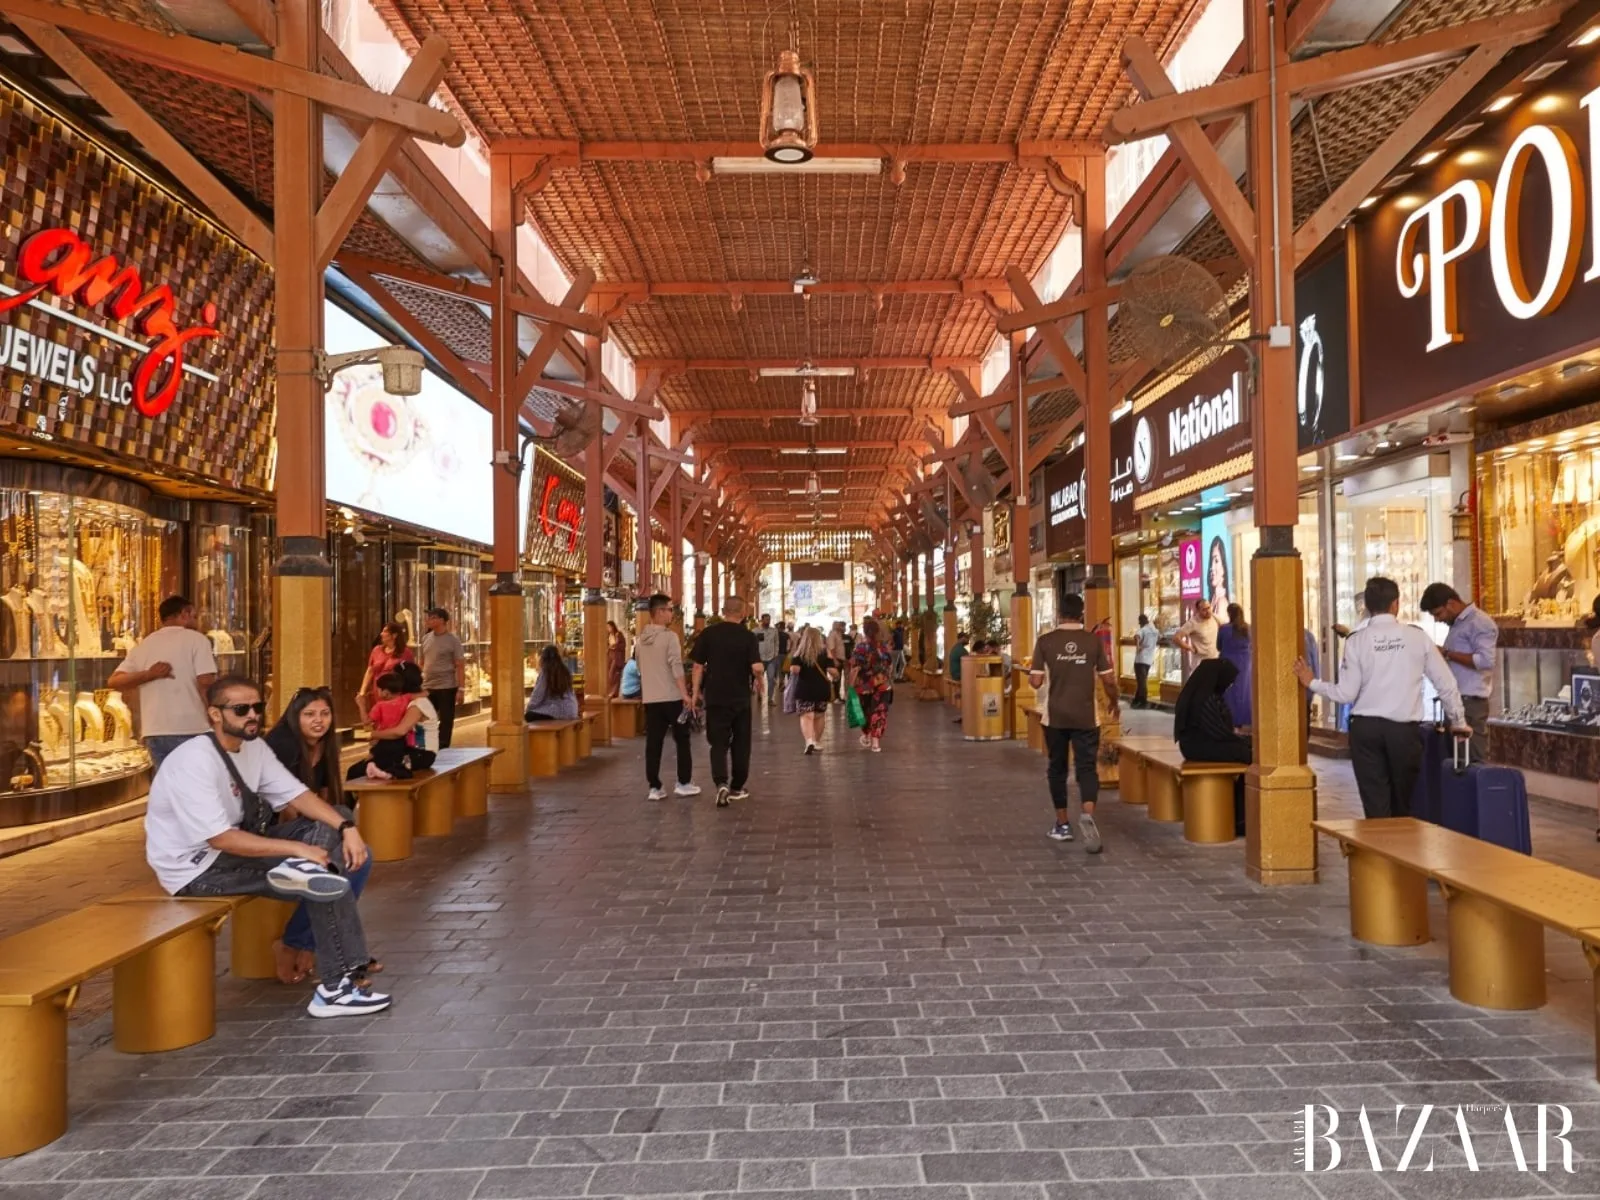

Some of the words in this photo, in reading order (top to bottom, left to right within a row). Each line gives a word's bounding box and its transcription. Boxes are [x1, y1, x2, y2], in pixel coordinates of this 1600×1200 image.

[1396, 86, 1600, 352] PO
[0, 325, 96, 394] JEWELS
[100, 373, 133, 405] LLC
[1169, 371, 1241, 457] National
